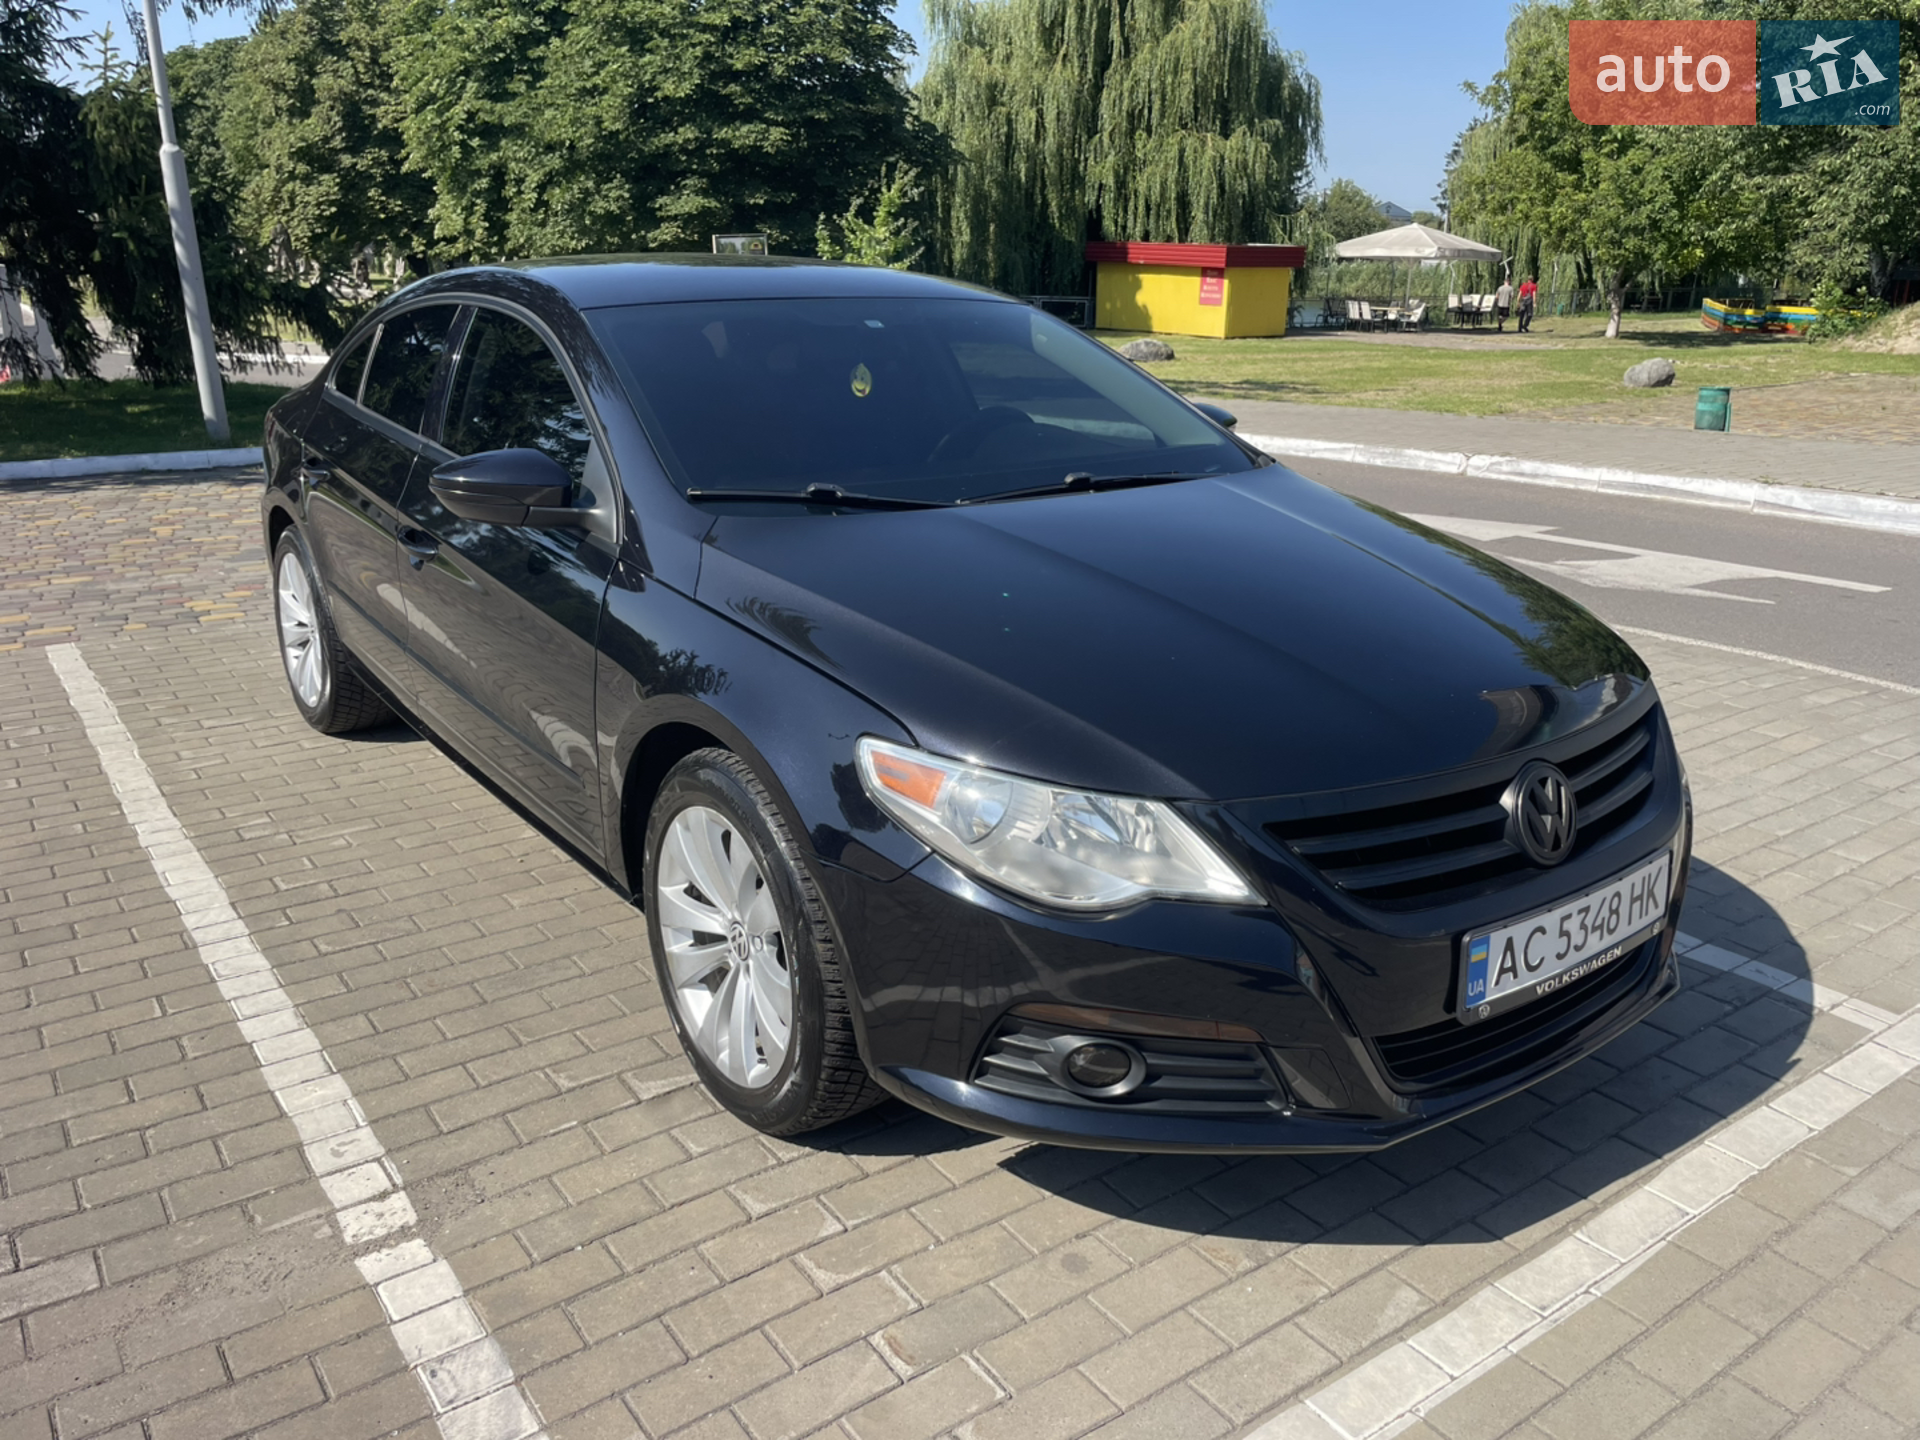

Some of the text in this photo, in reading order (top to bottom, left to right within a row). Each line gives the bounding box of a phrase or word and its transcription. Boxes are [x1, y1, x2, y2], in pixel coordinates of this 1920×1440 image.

[1491, 866, 1663, 988] AC 5348 HK
[1468, 978, 1485, 997] UA
[1536, 946, 1622, 996] VOLKSWAGEN
